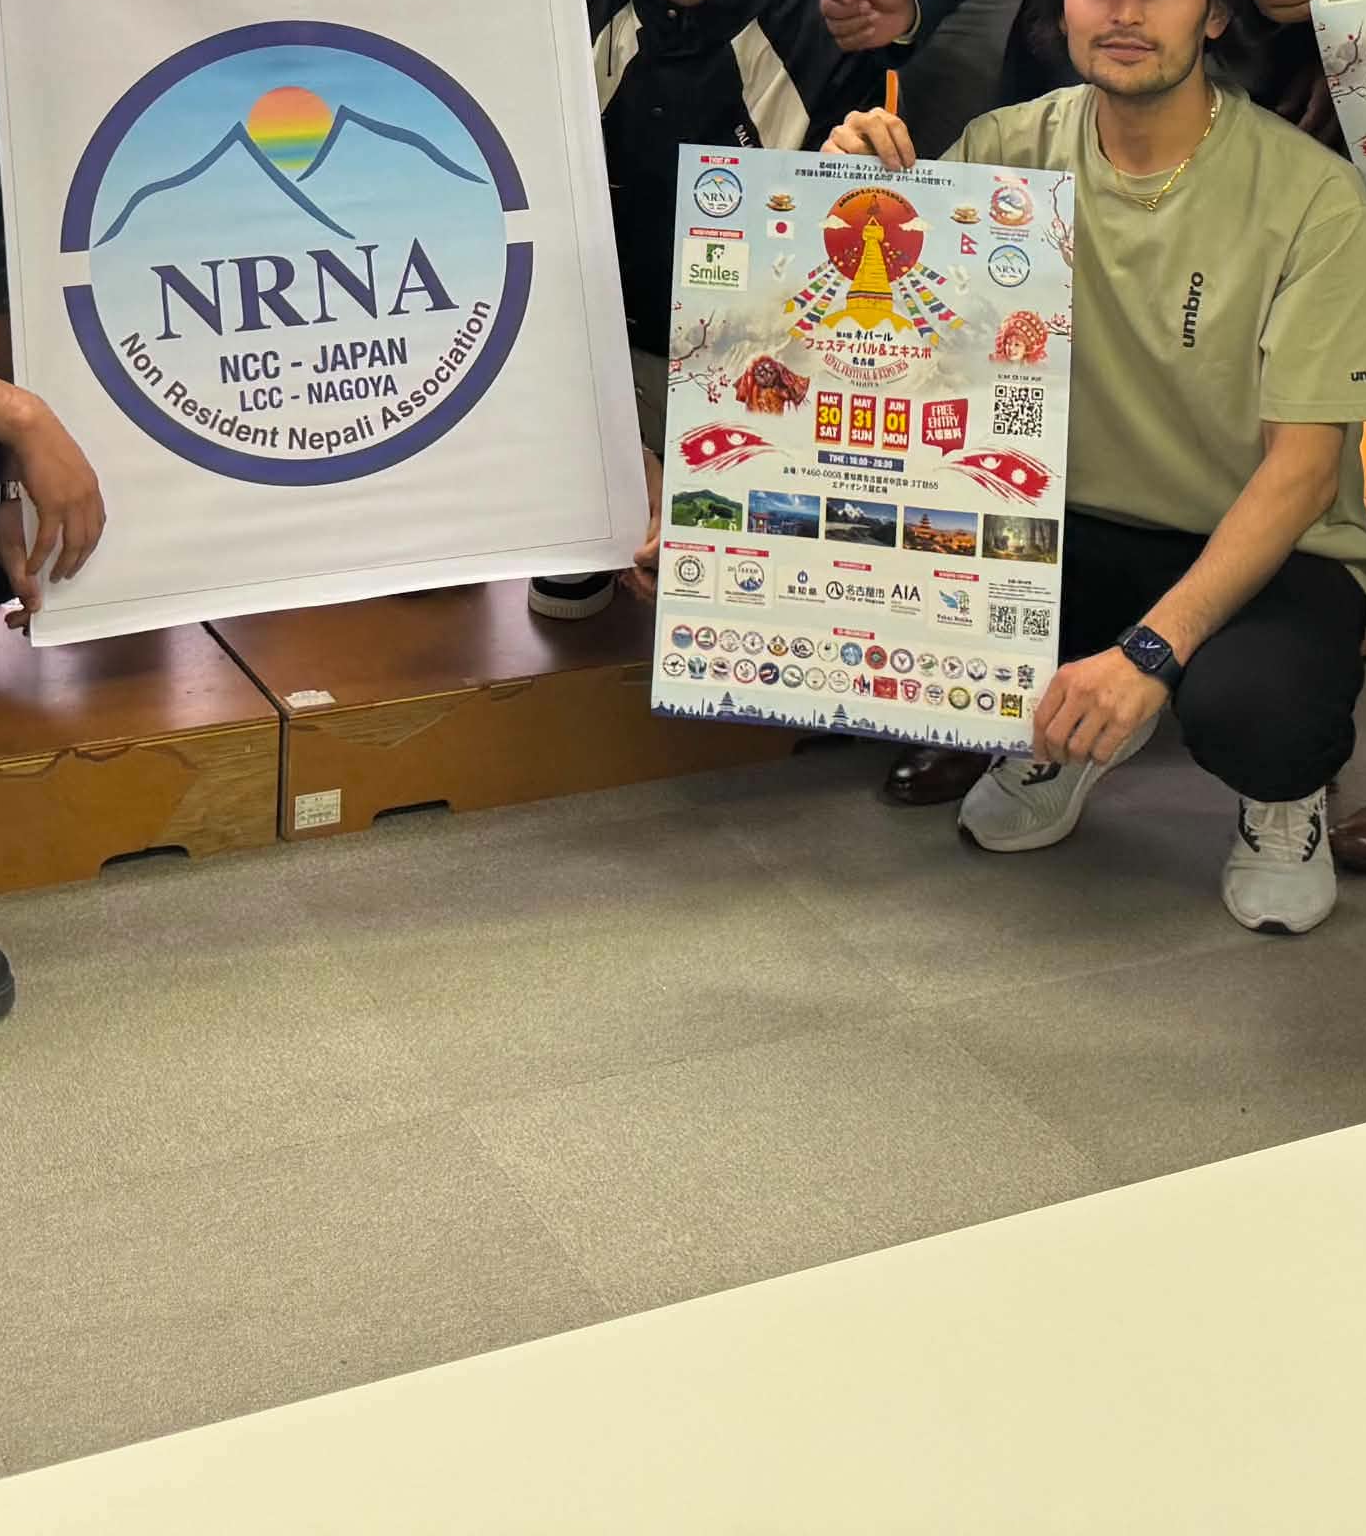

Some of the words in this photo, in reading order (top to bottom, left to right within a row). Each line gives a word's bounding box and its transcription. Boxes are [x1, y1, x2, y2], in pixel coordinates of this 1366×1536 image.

[703, 191, 733, 202] NRNA
[690, 264, 739, 281] Smiles
[150, 237, 460, 342] NRNA
[1183, 272, 1204, 348] umbro
[855, 330, 893, 341] ネパール
[219, 351, 280, 385] NCC
[313, 337, 408, 375] JAPAN
[119, 332, 164, 389] Non
[164, 381, 279, 449] Resident
[288, 418, 375, 454] Nepali
[381, 300, 492, 432] Association
[239, 388, 283, 412] LCC
[307, 375, 399, 405] NAGOYA
[820, 394, 839, 405] MAY
[853, 397, 871, 408] MAY
[888, 402, 905, 412] JUN
[931, 403, 954, 416] FREE
[818, 406, 841, 425] 30
[854, 410, 872, 429] 31
[886, 413, 906, 431] 01
[928, 415, 961, 429] ENTRY
[819, 426, 838, 437] SAT
[851, 429, 872, 441] SUN
[883, 433, 908, 446] MON
[891, 584, 921, 601] AIA
